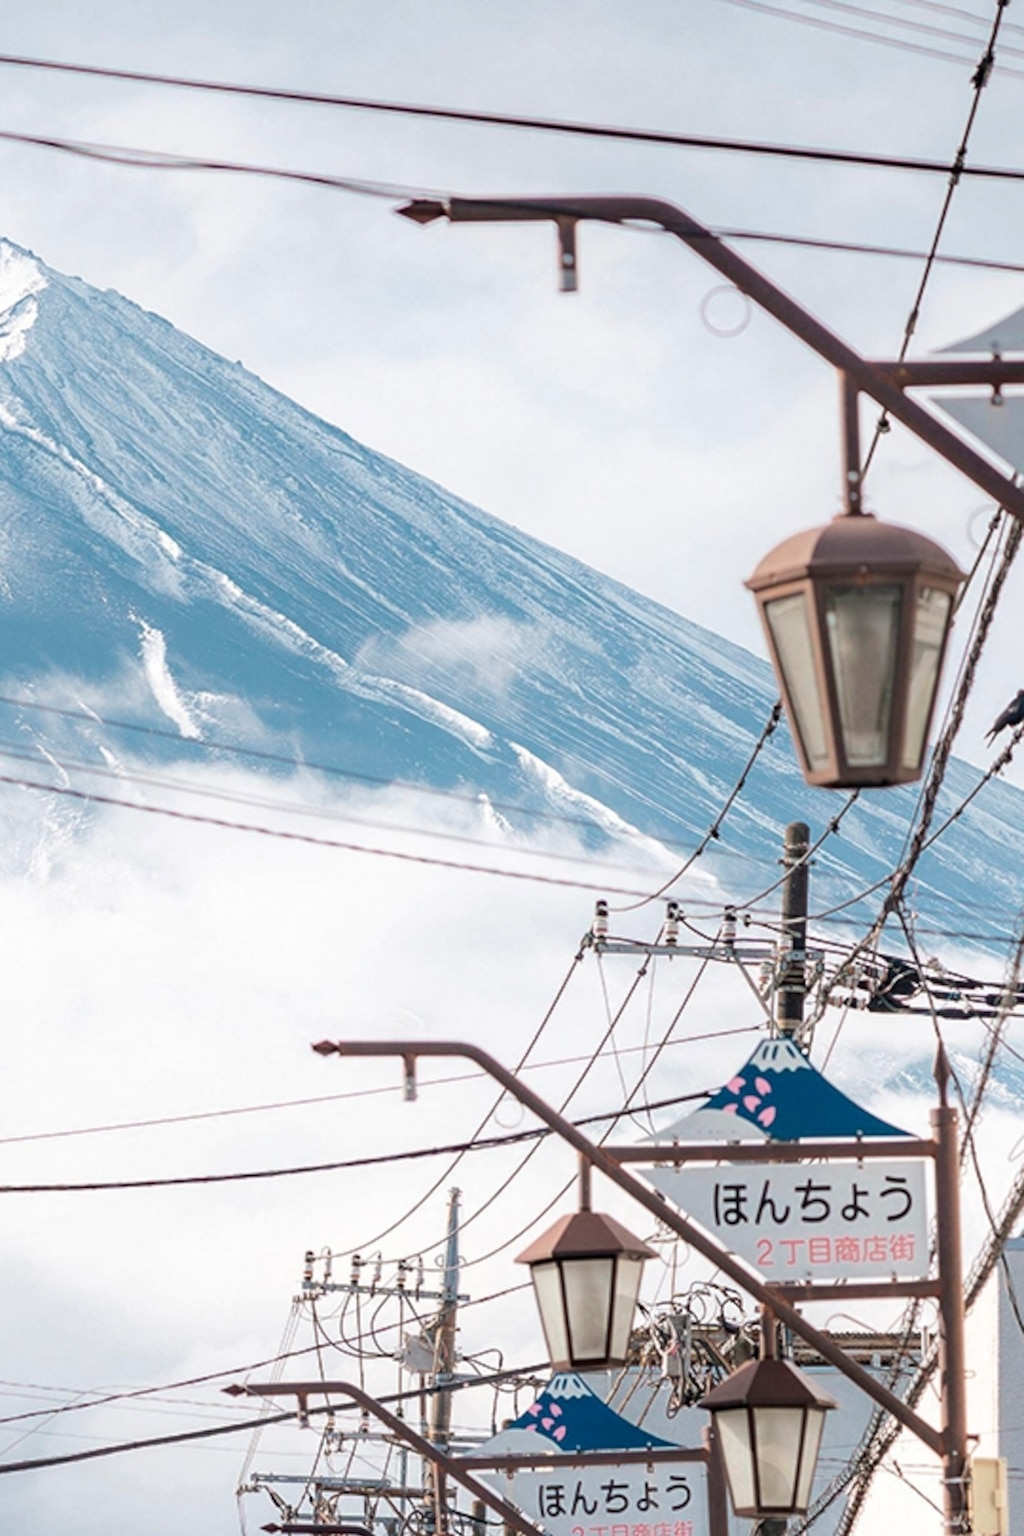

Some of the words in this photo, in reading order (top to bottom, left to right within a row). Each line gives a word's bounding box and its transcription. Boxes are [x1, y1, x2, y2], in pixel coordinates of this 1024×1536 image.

[714, 1176, 912, 1226] ほんちょう
[756, 1234, 915, 1266] 2丁目商店街
[538, 1475, 692, 1517] ほんちょう
